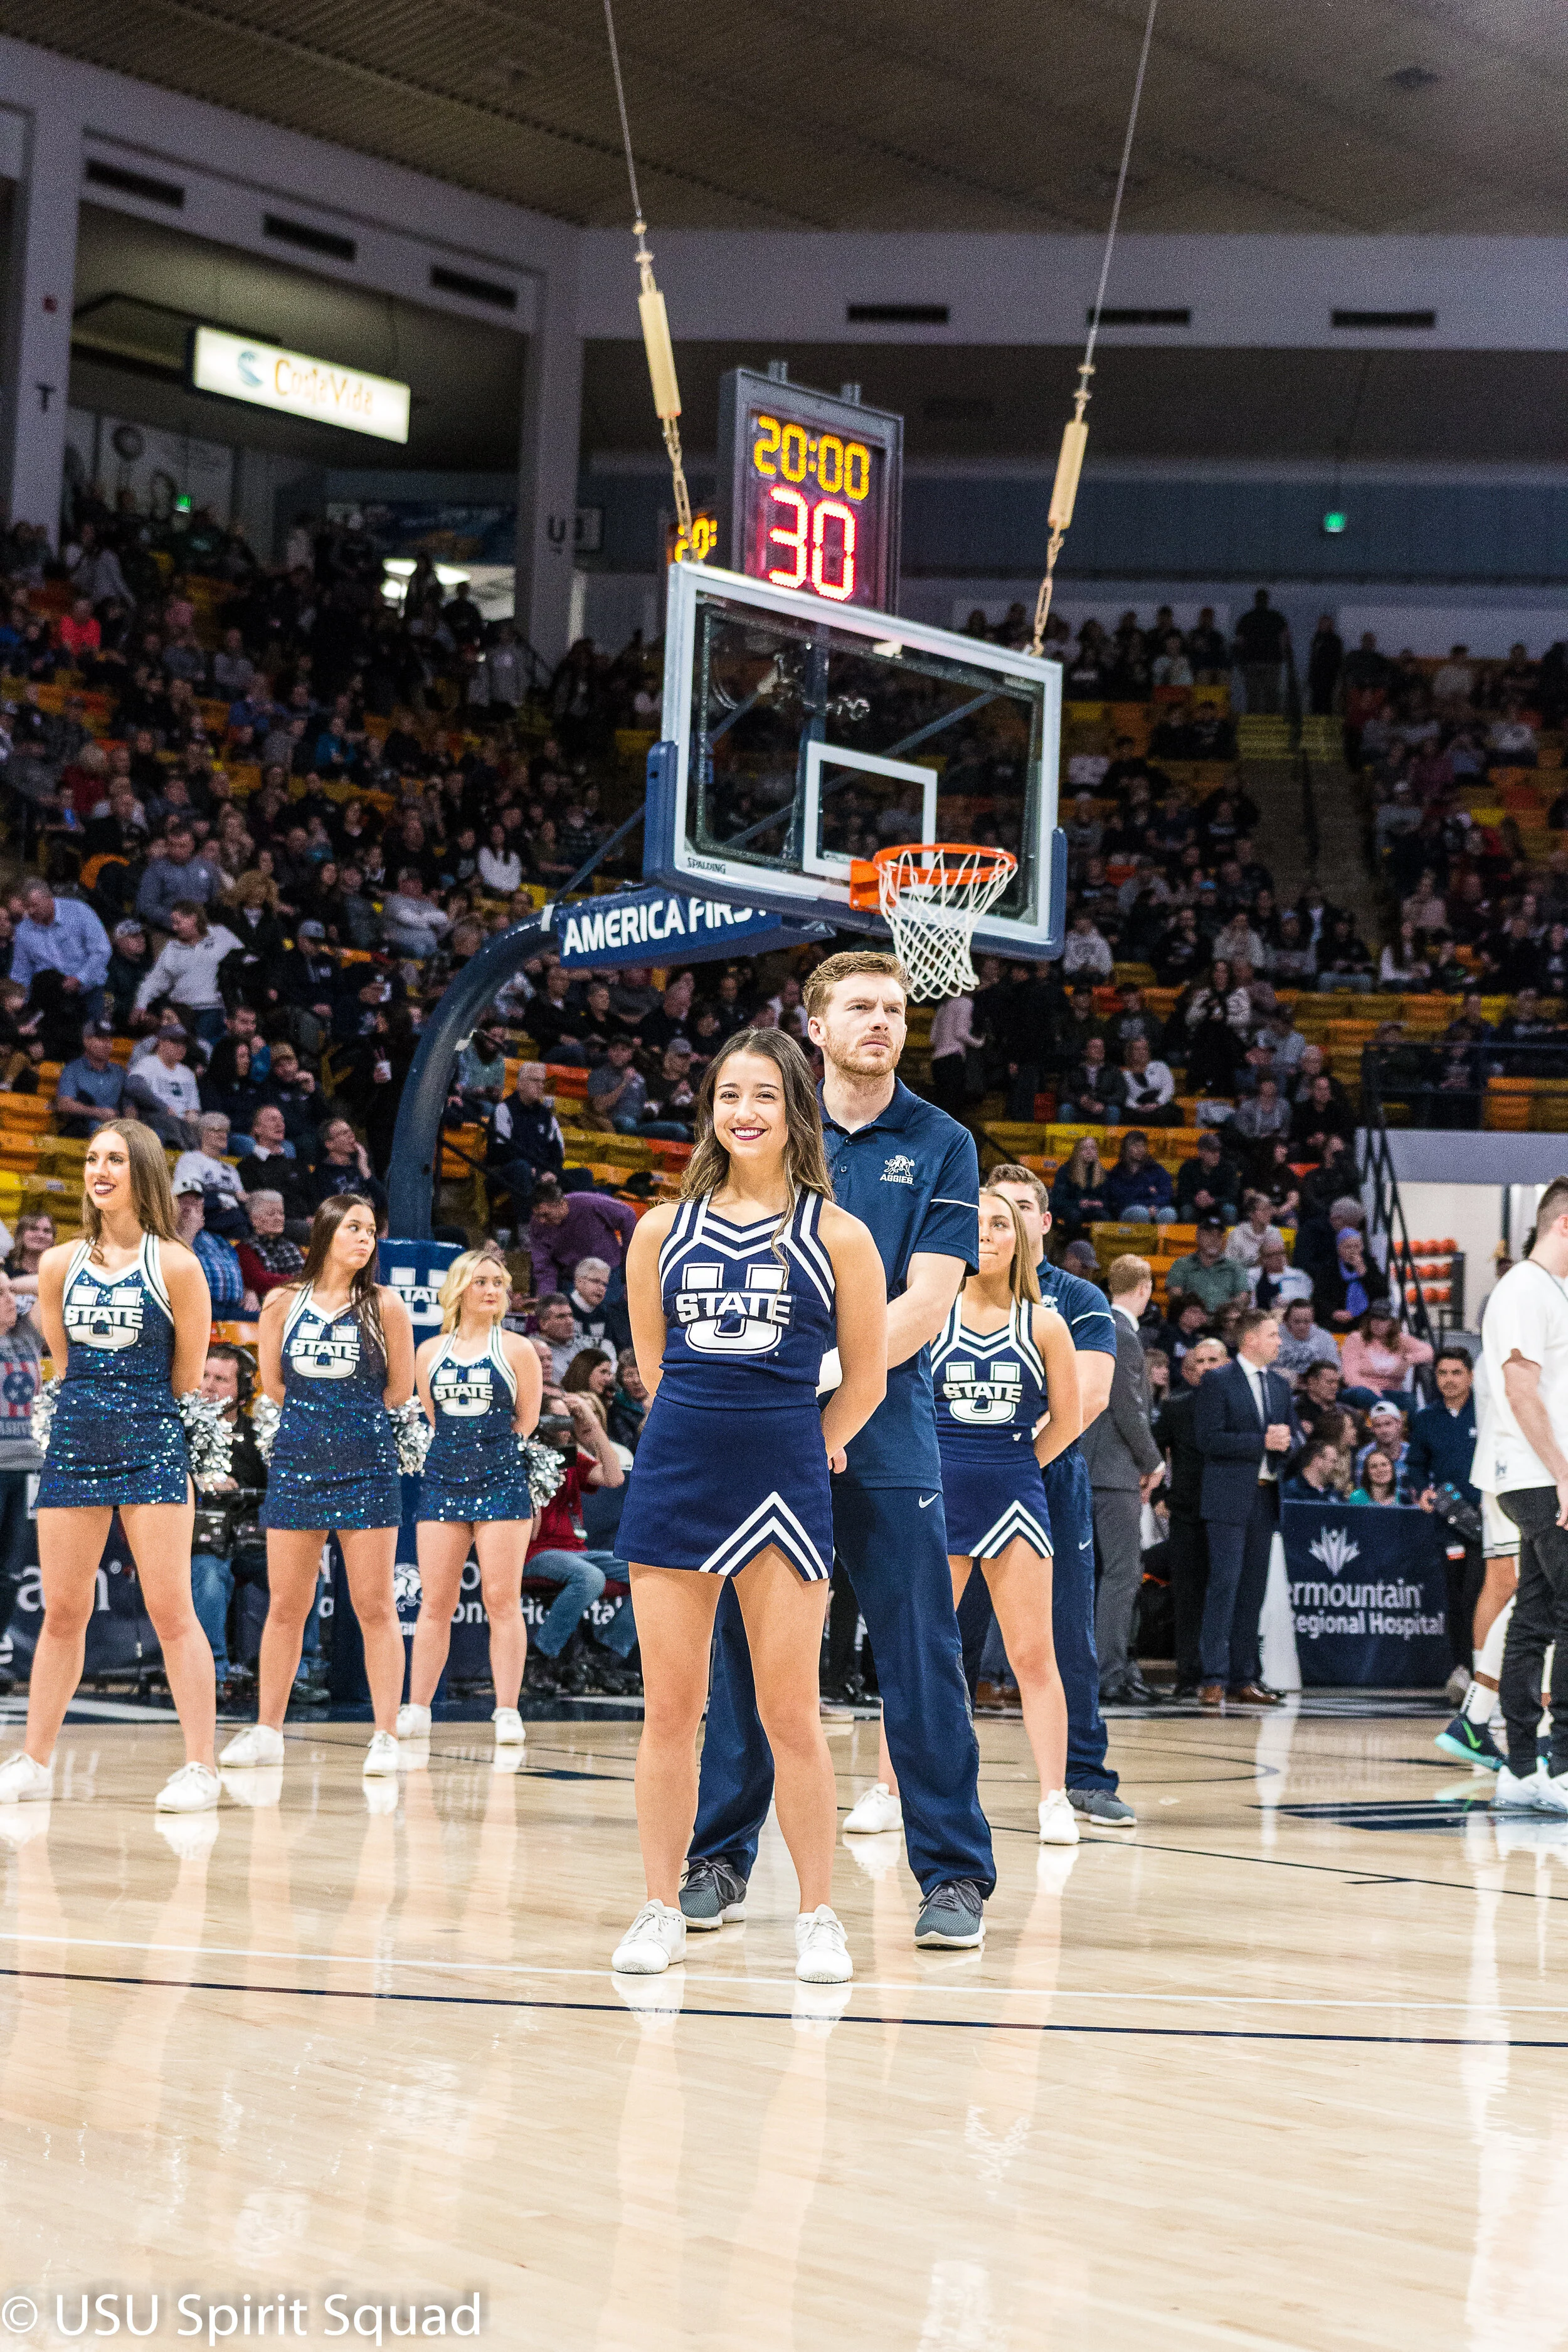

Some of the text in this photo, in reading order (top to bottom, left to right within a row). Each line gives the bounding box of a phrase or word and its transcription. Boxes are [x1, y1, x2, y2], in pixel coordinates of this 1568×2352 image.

[754, 415, 870, 501] 20:00
[769, 484, 857, 601] 30
[687, 857, 726, 874] SPALDING
[563, 899, 686, 956] AMERICA
[879, 1173, 914, 1185] AGGIES
[64, 1305, 144, 1330] STATE
[675, 1291, 792, 1325] STATE
[290, 1338, 361, 1362] STATE
[433, 1383, 494, 1401] STATE
[942, 1381, 1023, 1403] STATE
[1293, 1609, 1445, 1641] egional Hospital
